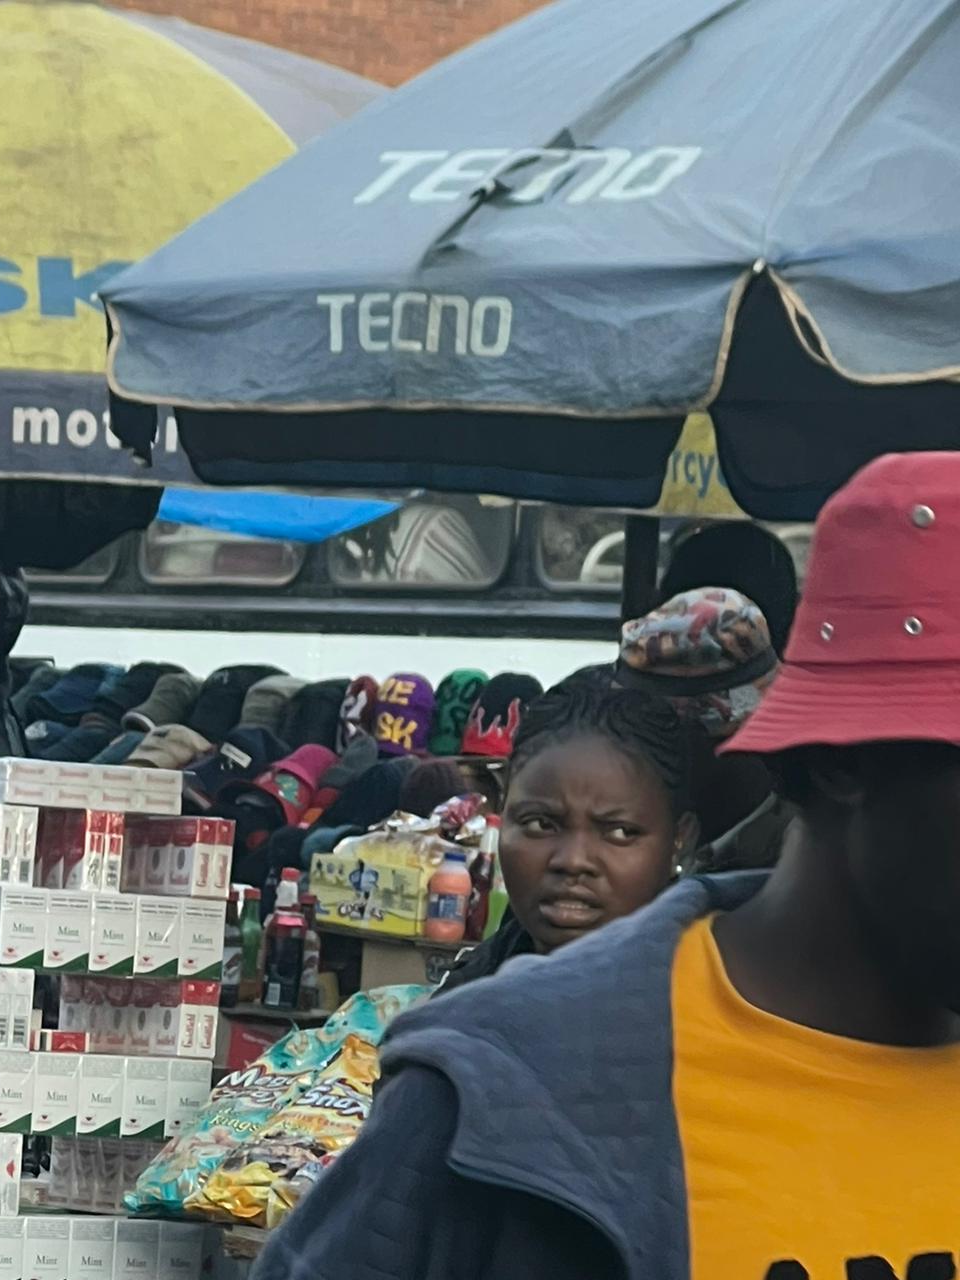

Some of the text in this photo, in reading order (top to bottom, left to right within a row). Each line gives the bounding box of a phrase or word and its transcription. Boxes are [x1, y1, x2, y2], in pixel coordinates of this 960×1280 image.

[352, 145, 702, 205] TECNO
[316, 291, 513, 357] TECNO
[671, 449, 728, 498] rcy
[12, 921, 34, 934] Mint
[57, 925, 80, 937] Mint
[102, 929, 124, 940] Mint
[0, 1087, 22, 1099] Mint
[46, 1090, 68, 1102] Mint
[91, 1092, 112, 1104] Mint
[135, 1095, 157, 1106] Mint
[35, 1255, 58, 1266] Mint
[81, 1255, 103, 1267] Mint
[125, 1257, 147, 1268] Mint
